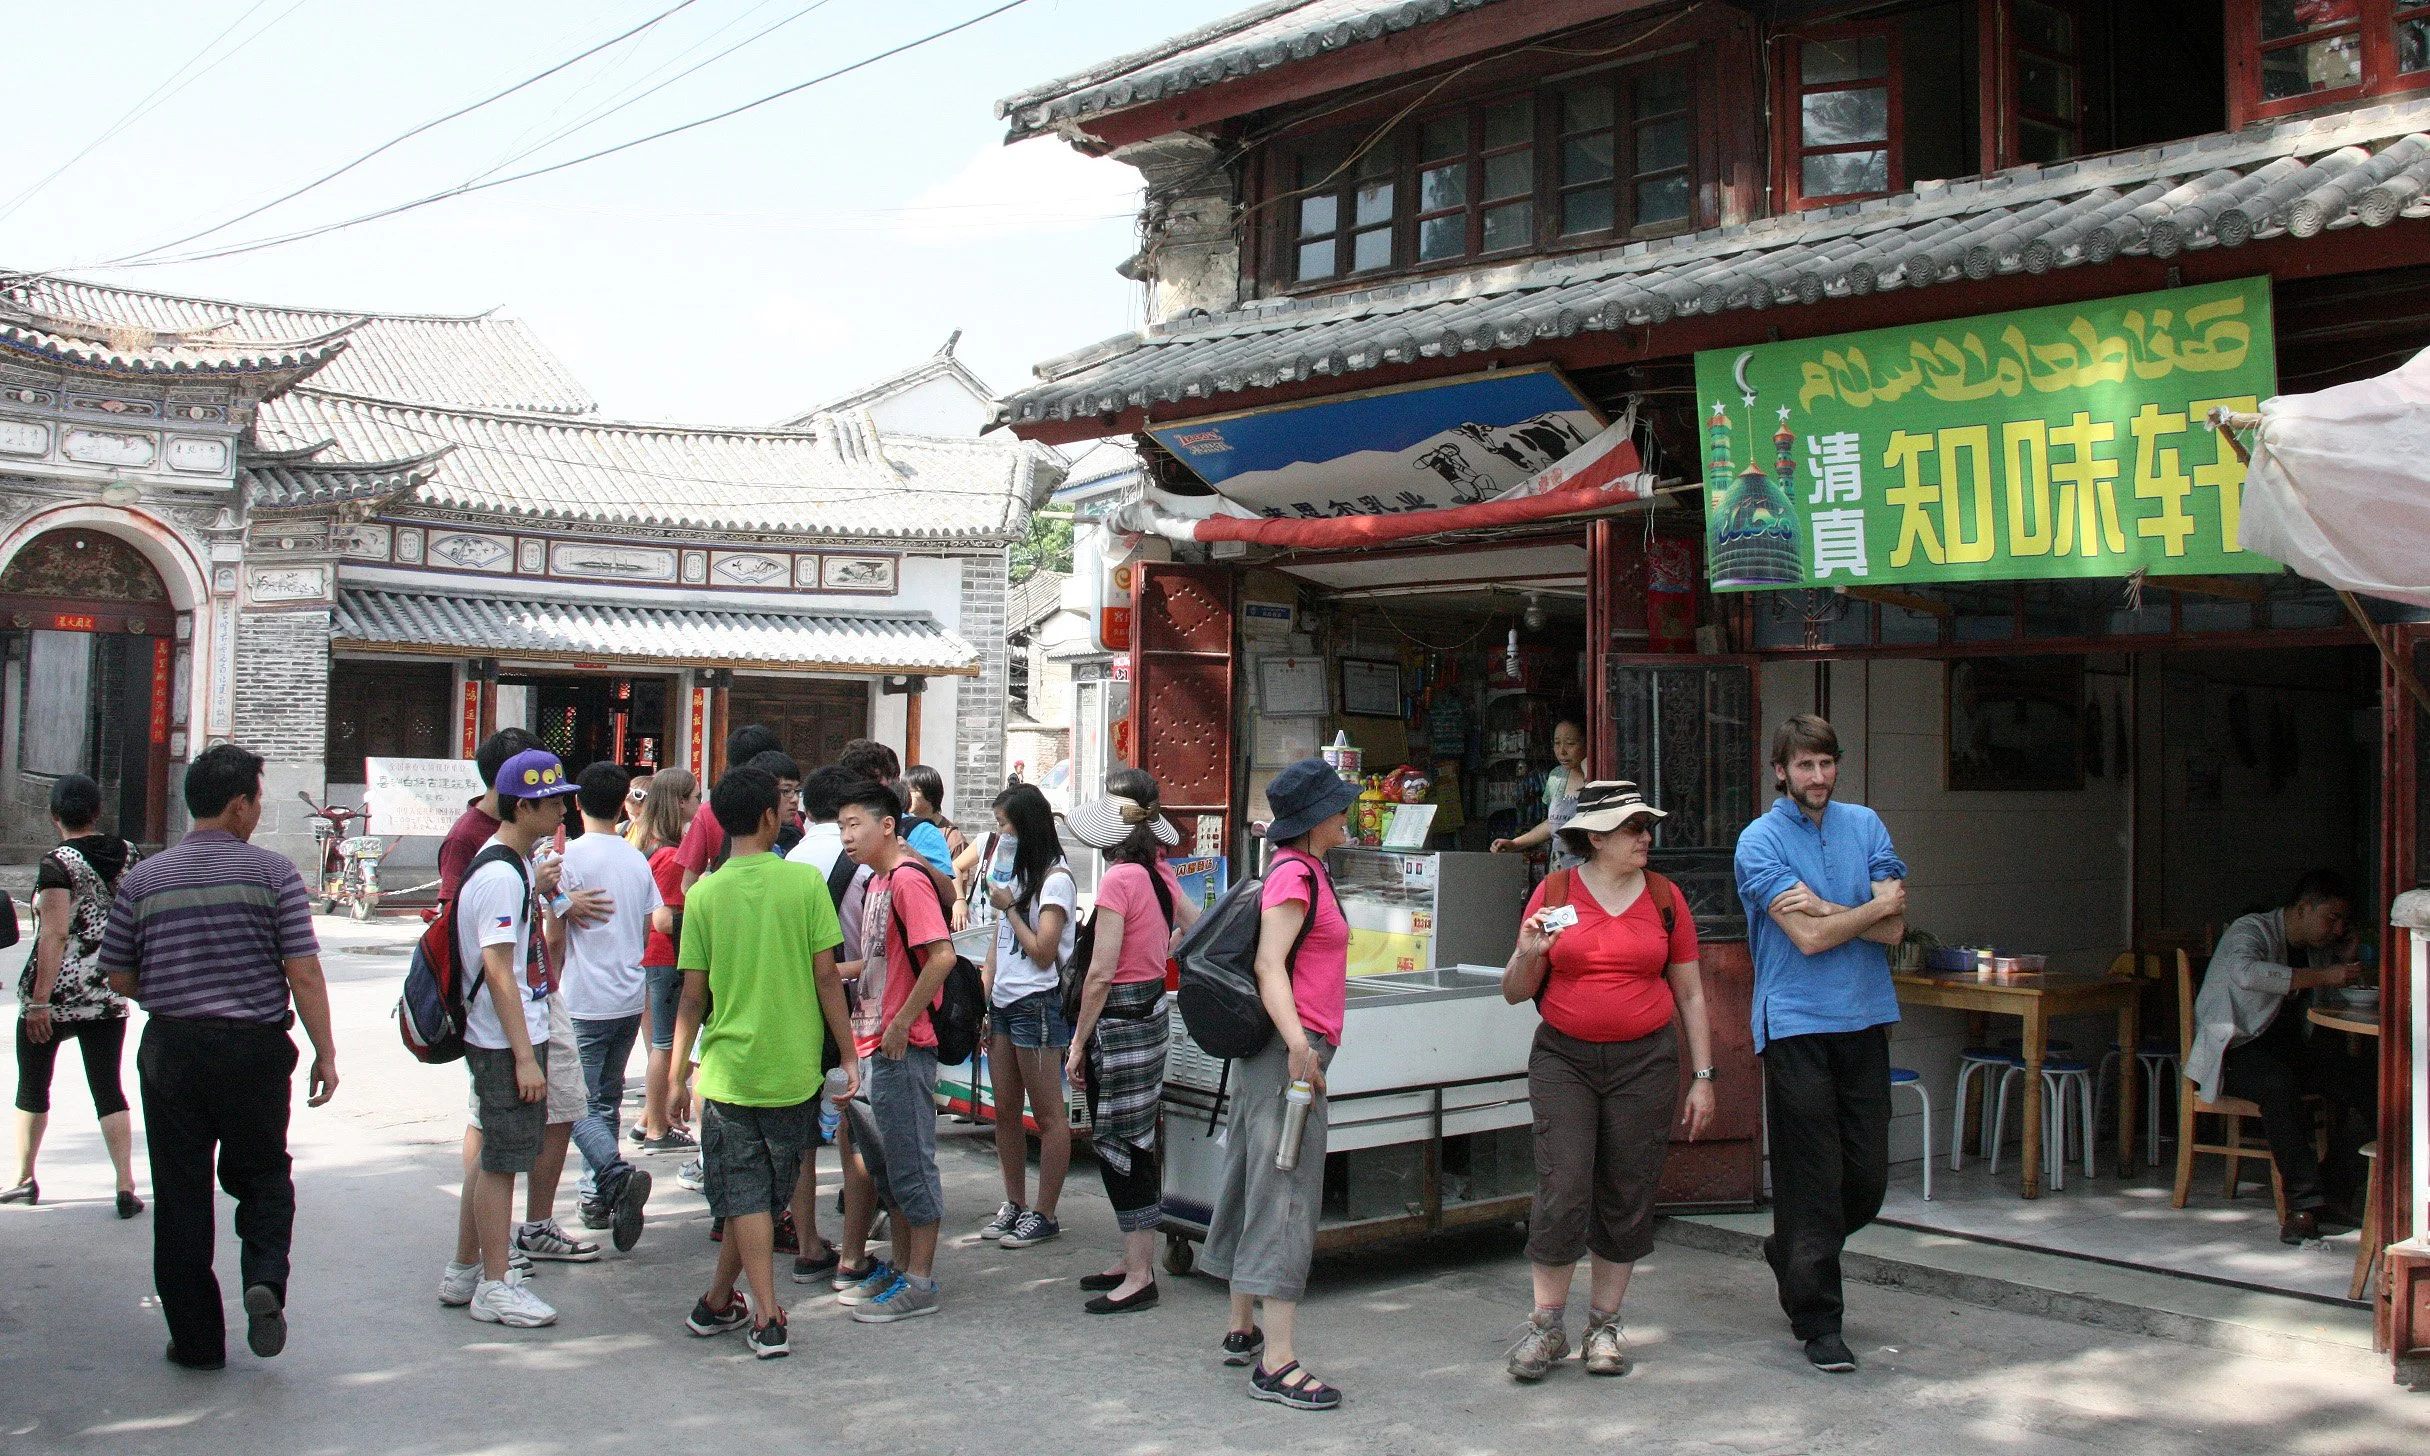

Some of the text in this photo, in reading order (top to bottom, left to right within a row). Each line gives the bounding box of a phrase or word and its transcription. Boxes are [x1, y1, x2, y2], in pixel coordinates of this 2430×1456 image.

[1807, 431, 1869, 577] 清真
[1882, 394, 2258, 569] 知味轩
